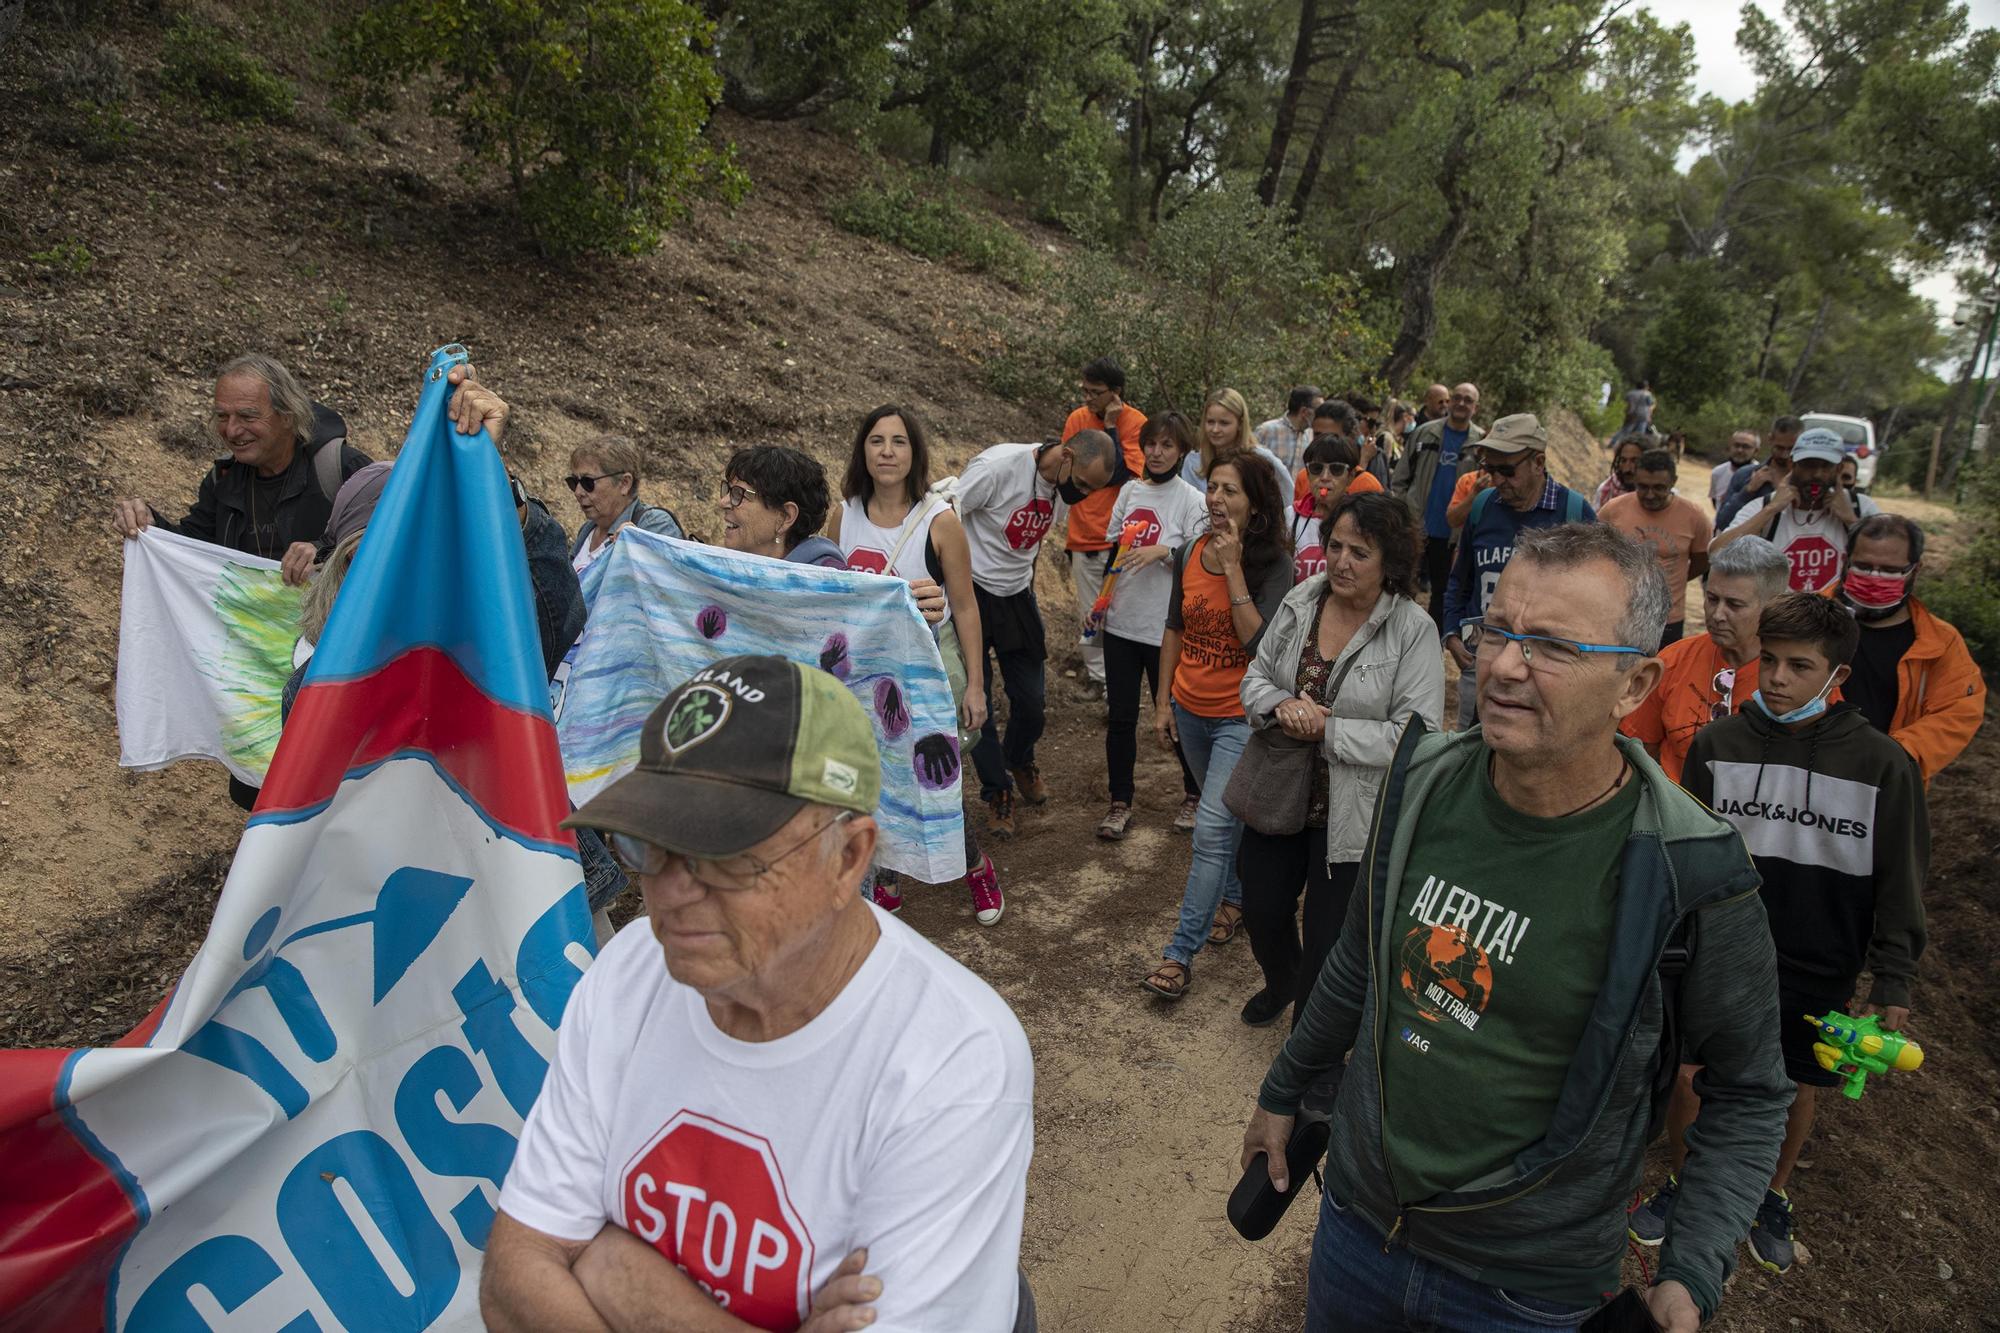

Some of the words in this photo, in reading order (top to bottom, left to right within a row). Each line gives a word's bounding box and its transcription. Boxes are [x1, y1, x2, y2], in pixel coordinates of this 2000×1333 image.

[1294, 558, 1328, 577] STO
[1785, 548, 1836, 568] STOP
[1717, 799, 1869, 840] JACK&JONES
[1409, 875, 1531, 965] ALERTA!
[1424, 981, 1454, 1009] MOLT
[1446, 998, 1481, 1032] FRÀGIL
[634, 1172, 790, 1296] STOP
